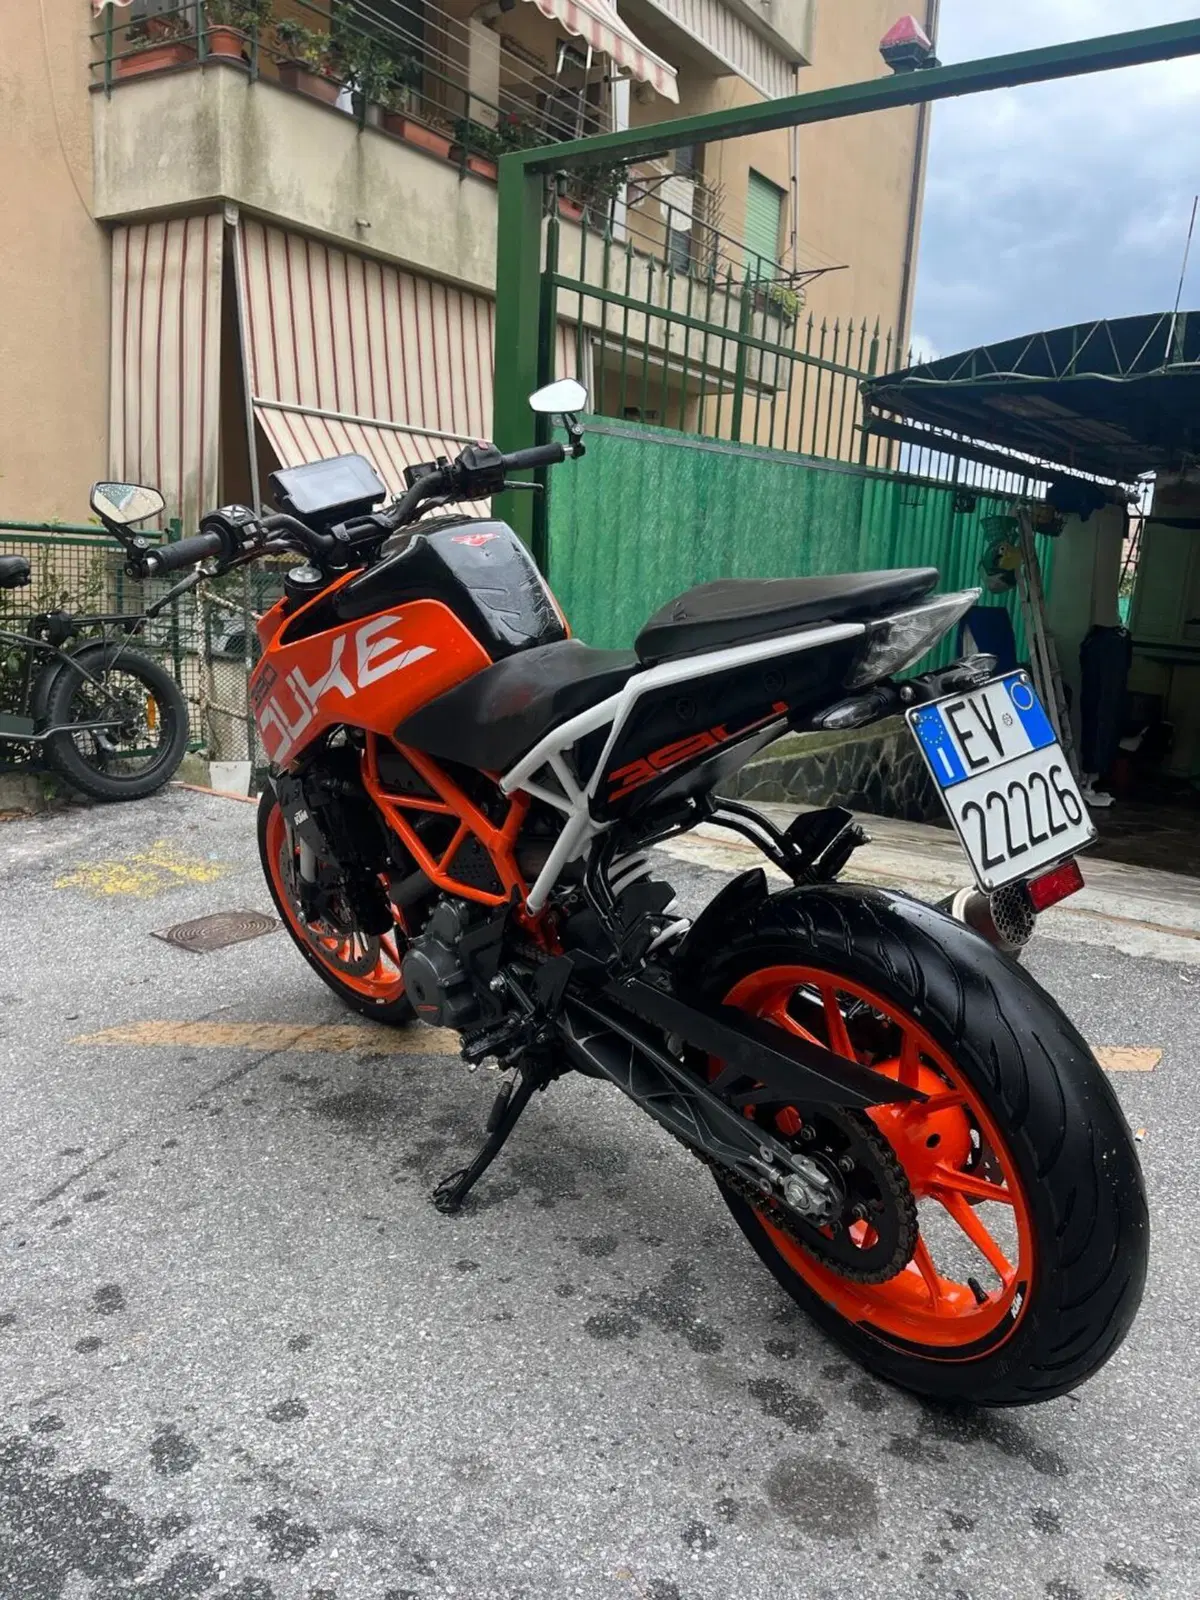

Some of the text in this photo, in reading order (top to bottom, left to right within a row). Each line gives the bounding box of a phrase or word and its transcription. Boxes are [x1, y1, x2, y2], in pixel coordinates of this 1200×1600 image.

[259, 615, 437, 766] DUKE
[944, 693, 1005, 770] EV
[961, 764, 1083, 871] 22226
